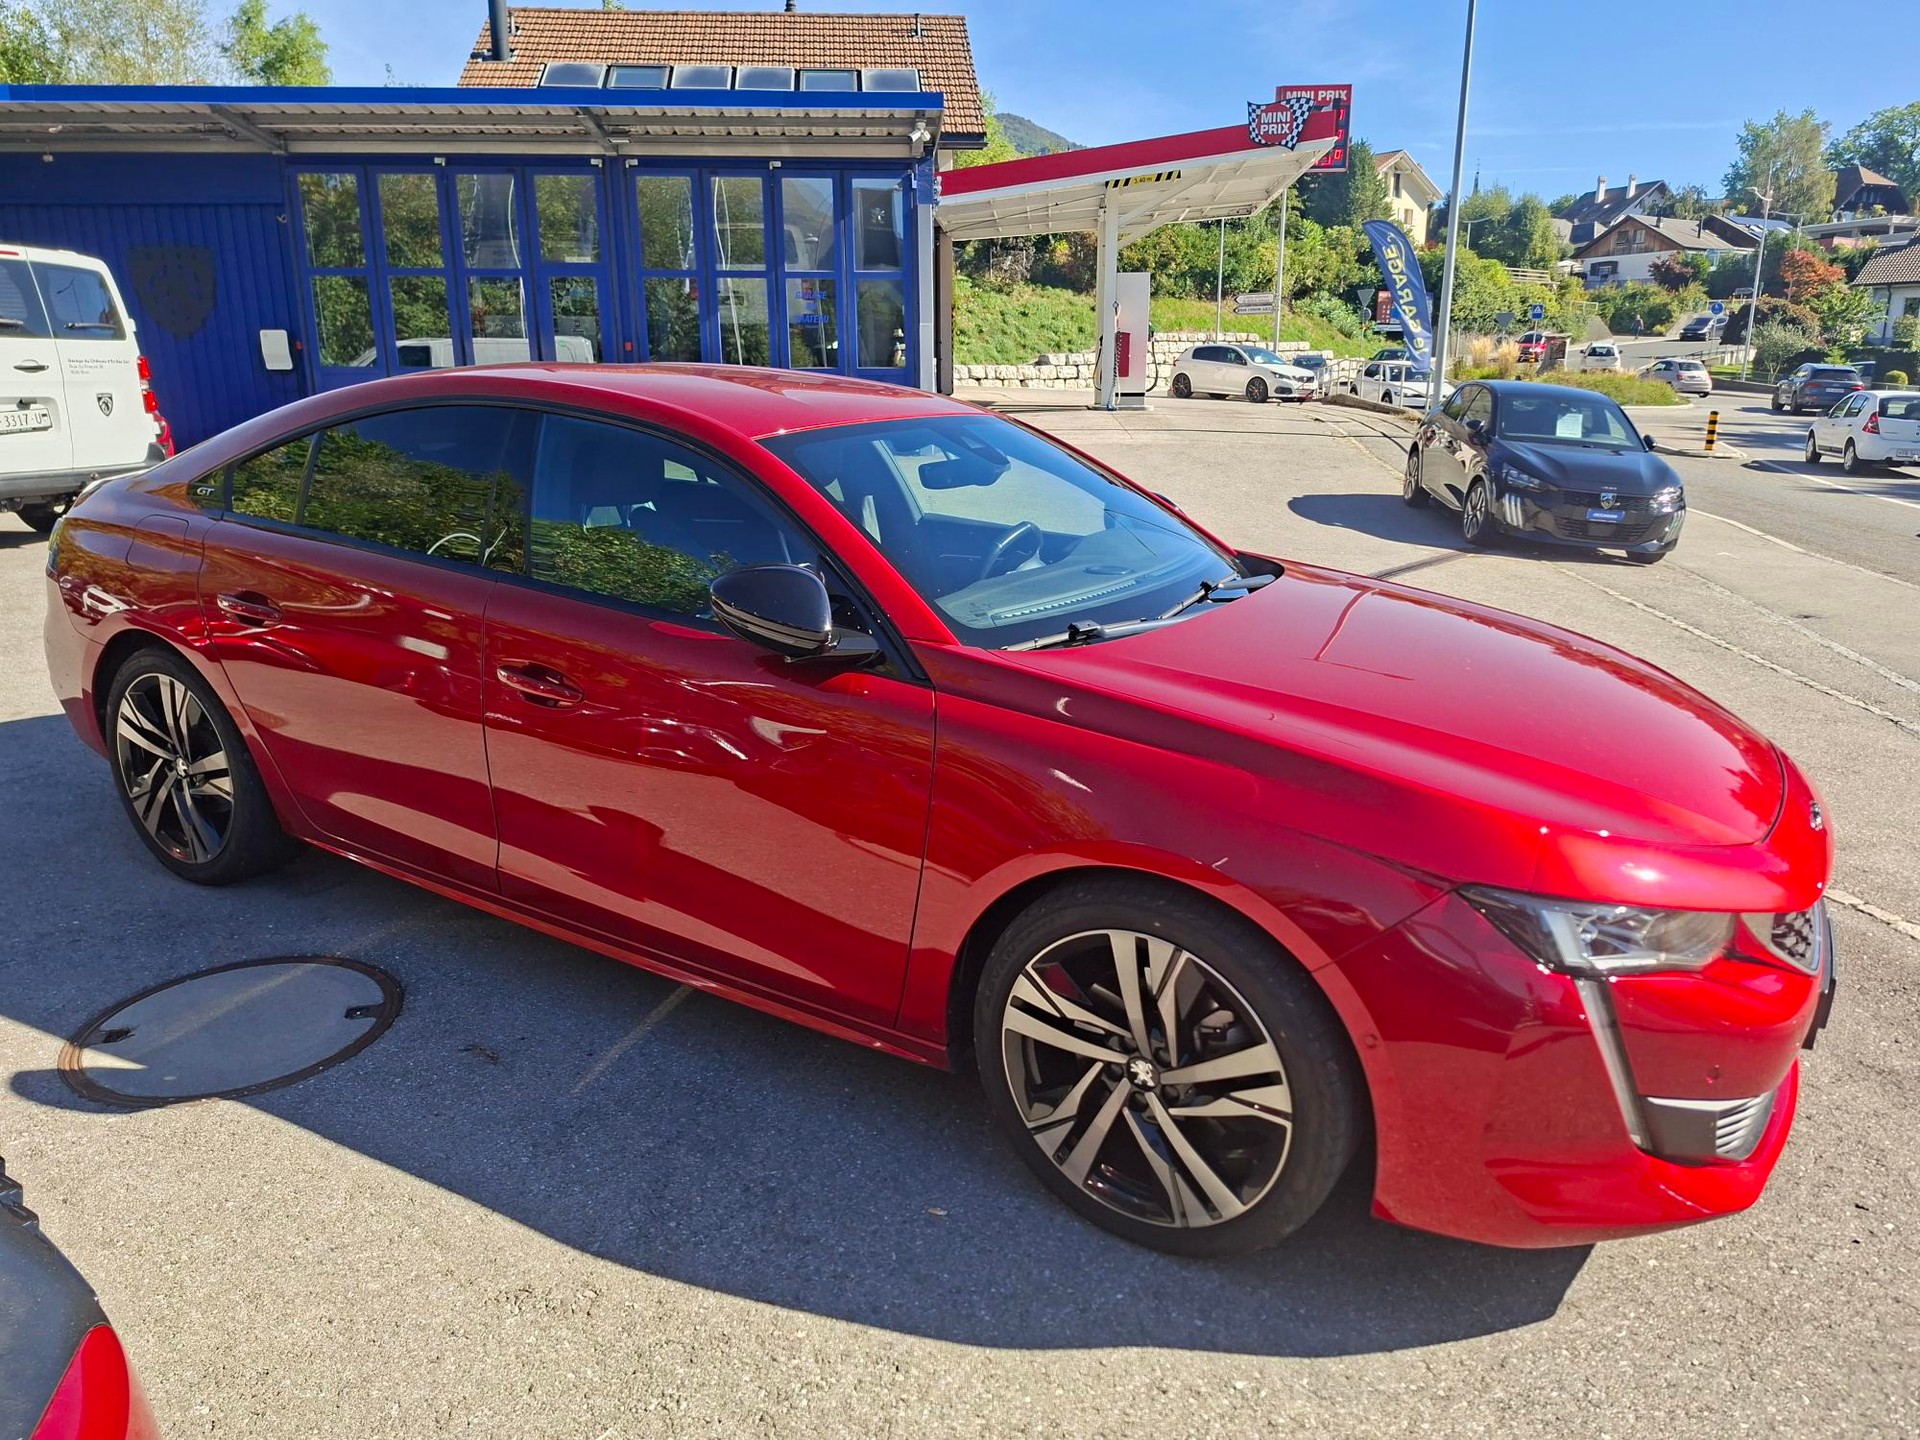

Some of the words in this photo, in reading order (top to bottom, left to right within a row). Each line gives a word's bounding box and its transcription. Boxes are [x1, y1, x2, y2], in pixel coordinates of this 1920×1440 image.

[1286, 90, 1314, 99] MINI
[1318, 90, 1347, 101] PRIX
[1260, 111, 1290, 123] MINI
[1260, 123, 1290, 135] PRIX
[196, 486, 215, 496] GT
